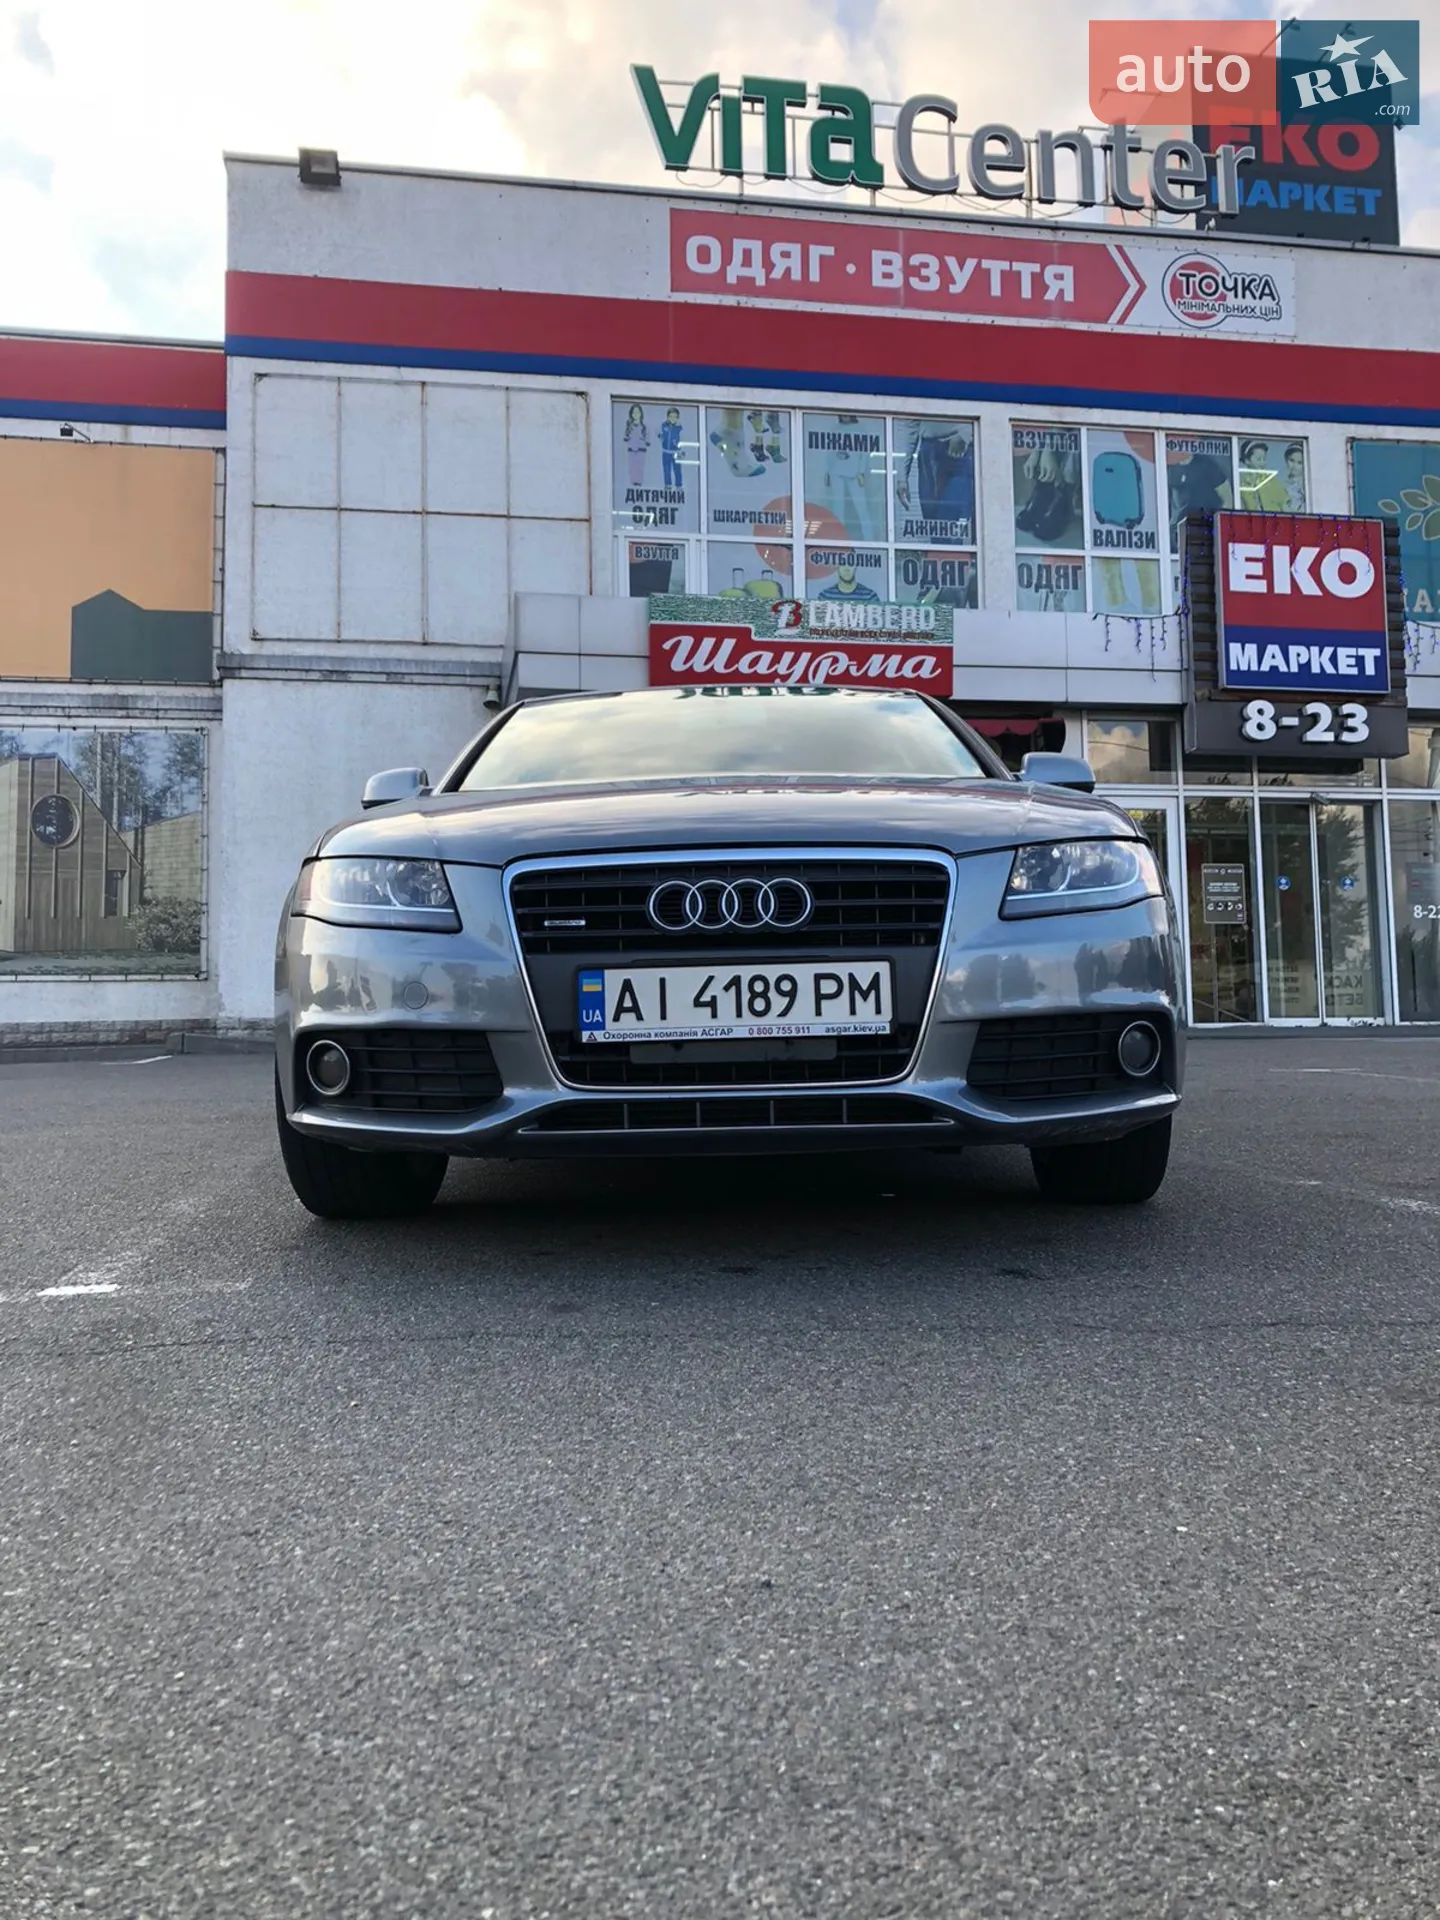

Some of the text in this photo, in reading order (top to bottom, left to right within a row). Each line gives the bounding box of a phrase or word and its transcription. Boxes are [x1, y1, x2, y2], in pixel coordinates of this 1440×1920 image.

[893, 94, 1256, 219] Center
[686, 234, 1075, 303] ОДЯГ ВЗУТТЯ
[1179, 273, 1276, 301] ТОЧКА
[1177, 300, 1279, 318] МІНІМАЛЬНИХ ЦІН
[808, 431, 880, 452] ПІЖАМИ
[1013, 429, 1078, 451] ВЗУТТЯ
[1166, 438, 1230, 455] ФУТБОЛКИ
[632, 506, 679, 527] ОДЯГ
[713, 509, 787, 525] ШКАРПЕТКИ
[903, 519, 970, 538] ДЖИНСИ
[1093, 529, 1156, 550] ВАЛІЗИ
[634, 545, 679, 561] ВЗУТТЯ
[810, 550, 882, 569] ФУТБОЛКИ
[903, 558, 968, 590] ОДЯГ
[1017, 562, 1084, 592] ОДЯГ
[1228, 541, 1375, 599] ЕКО
[661, 633, 942, 686] Шаурма
[1228, 641, 1381, 677] МАРКЕТ
[1241, 698, 1370, 745] 8-23
[692, 973, 799, 1020] 4189
[813, 971, 882, 1017] PM
[582, 1009, 603, 1024] UA
[603, 1024, 887, 1041] Охоронна компанія АСГАР 0 800 755 911 asgar.kiev.ua
